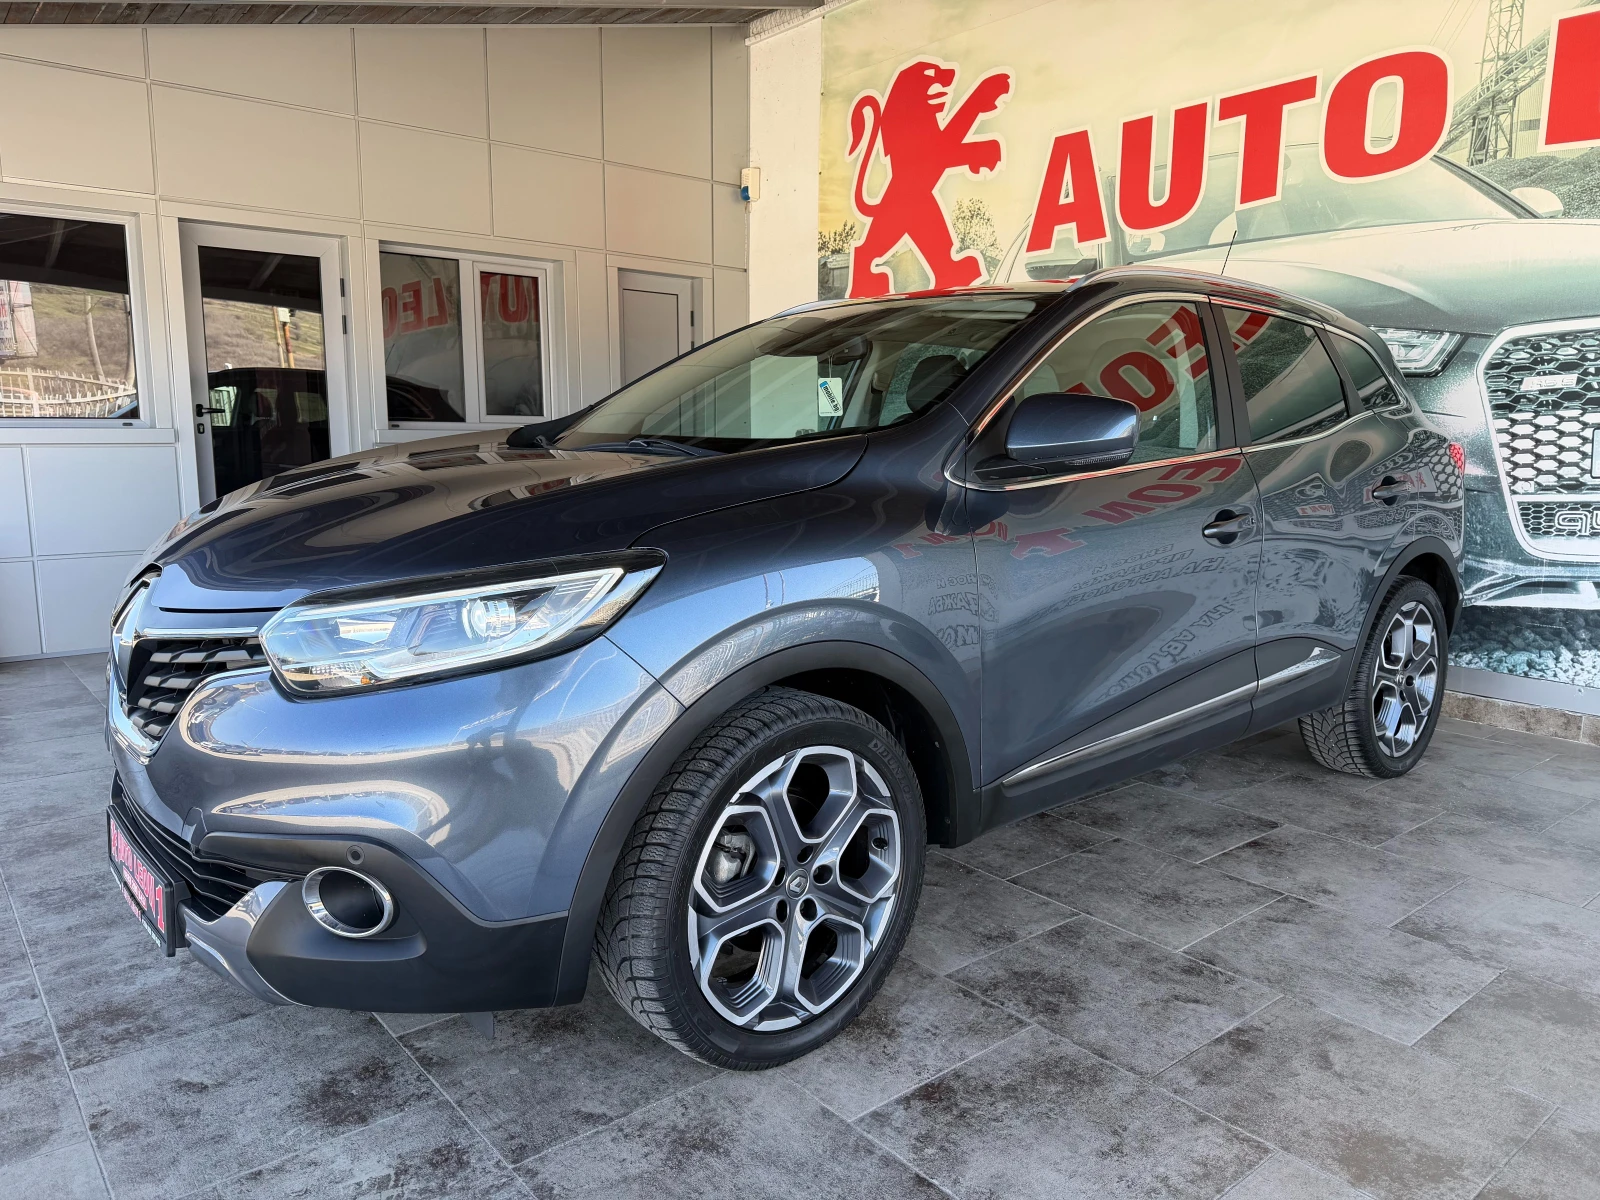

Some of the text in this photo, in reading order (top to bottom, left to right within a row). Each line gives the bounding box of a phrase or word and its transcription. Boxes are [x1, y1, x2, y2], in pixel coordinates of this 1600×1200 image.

[1025, 50, 1449, 253] AUTO
[822, 385, 841, 414] mobile.bg
[155, 884, 165, 934] 1
